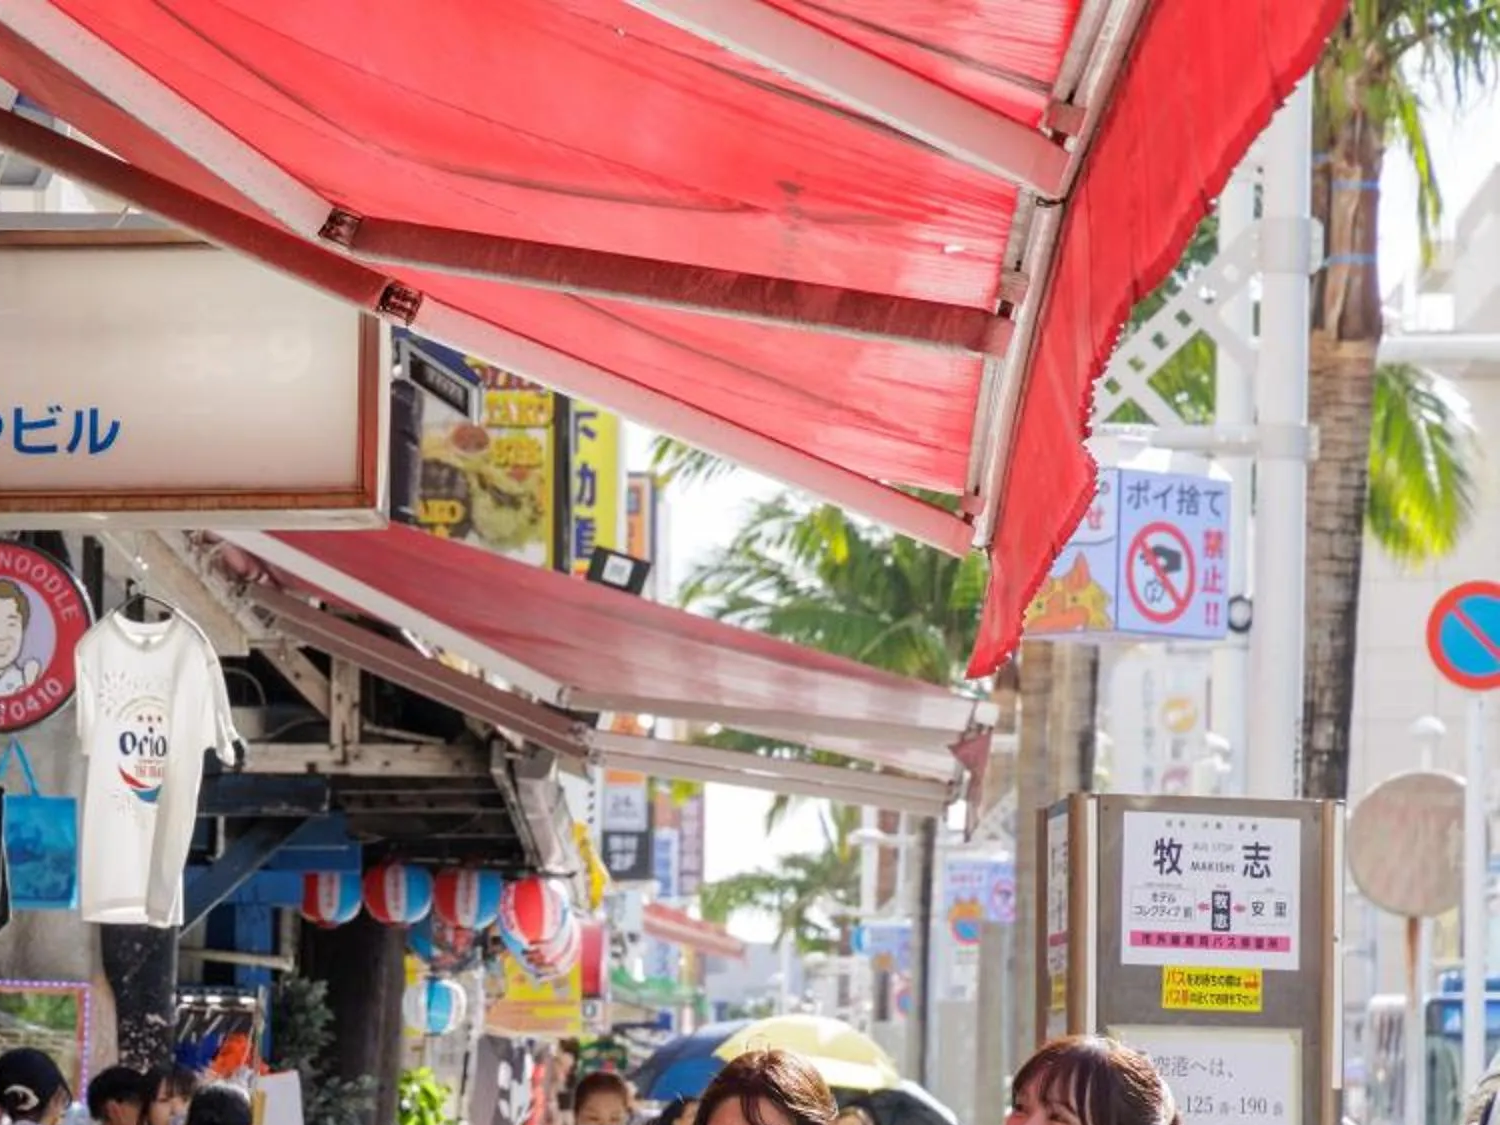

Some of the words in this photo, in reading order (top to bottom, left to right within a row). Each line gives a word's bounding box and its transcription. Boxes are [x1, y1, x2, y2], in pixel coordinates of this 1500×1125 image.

[1126, 482, 1225, 518] ポイ捨て
[1153, 837, 1183, 876] 牧
[1241, 841, 1272, 879] 志
[1190, 861, 1236, 873] MAKISHI
[1186, 1095, 1213, 1114] 125
[1239, 1096, 1268, 1115] 190
